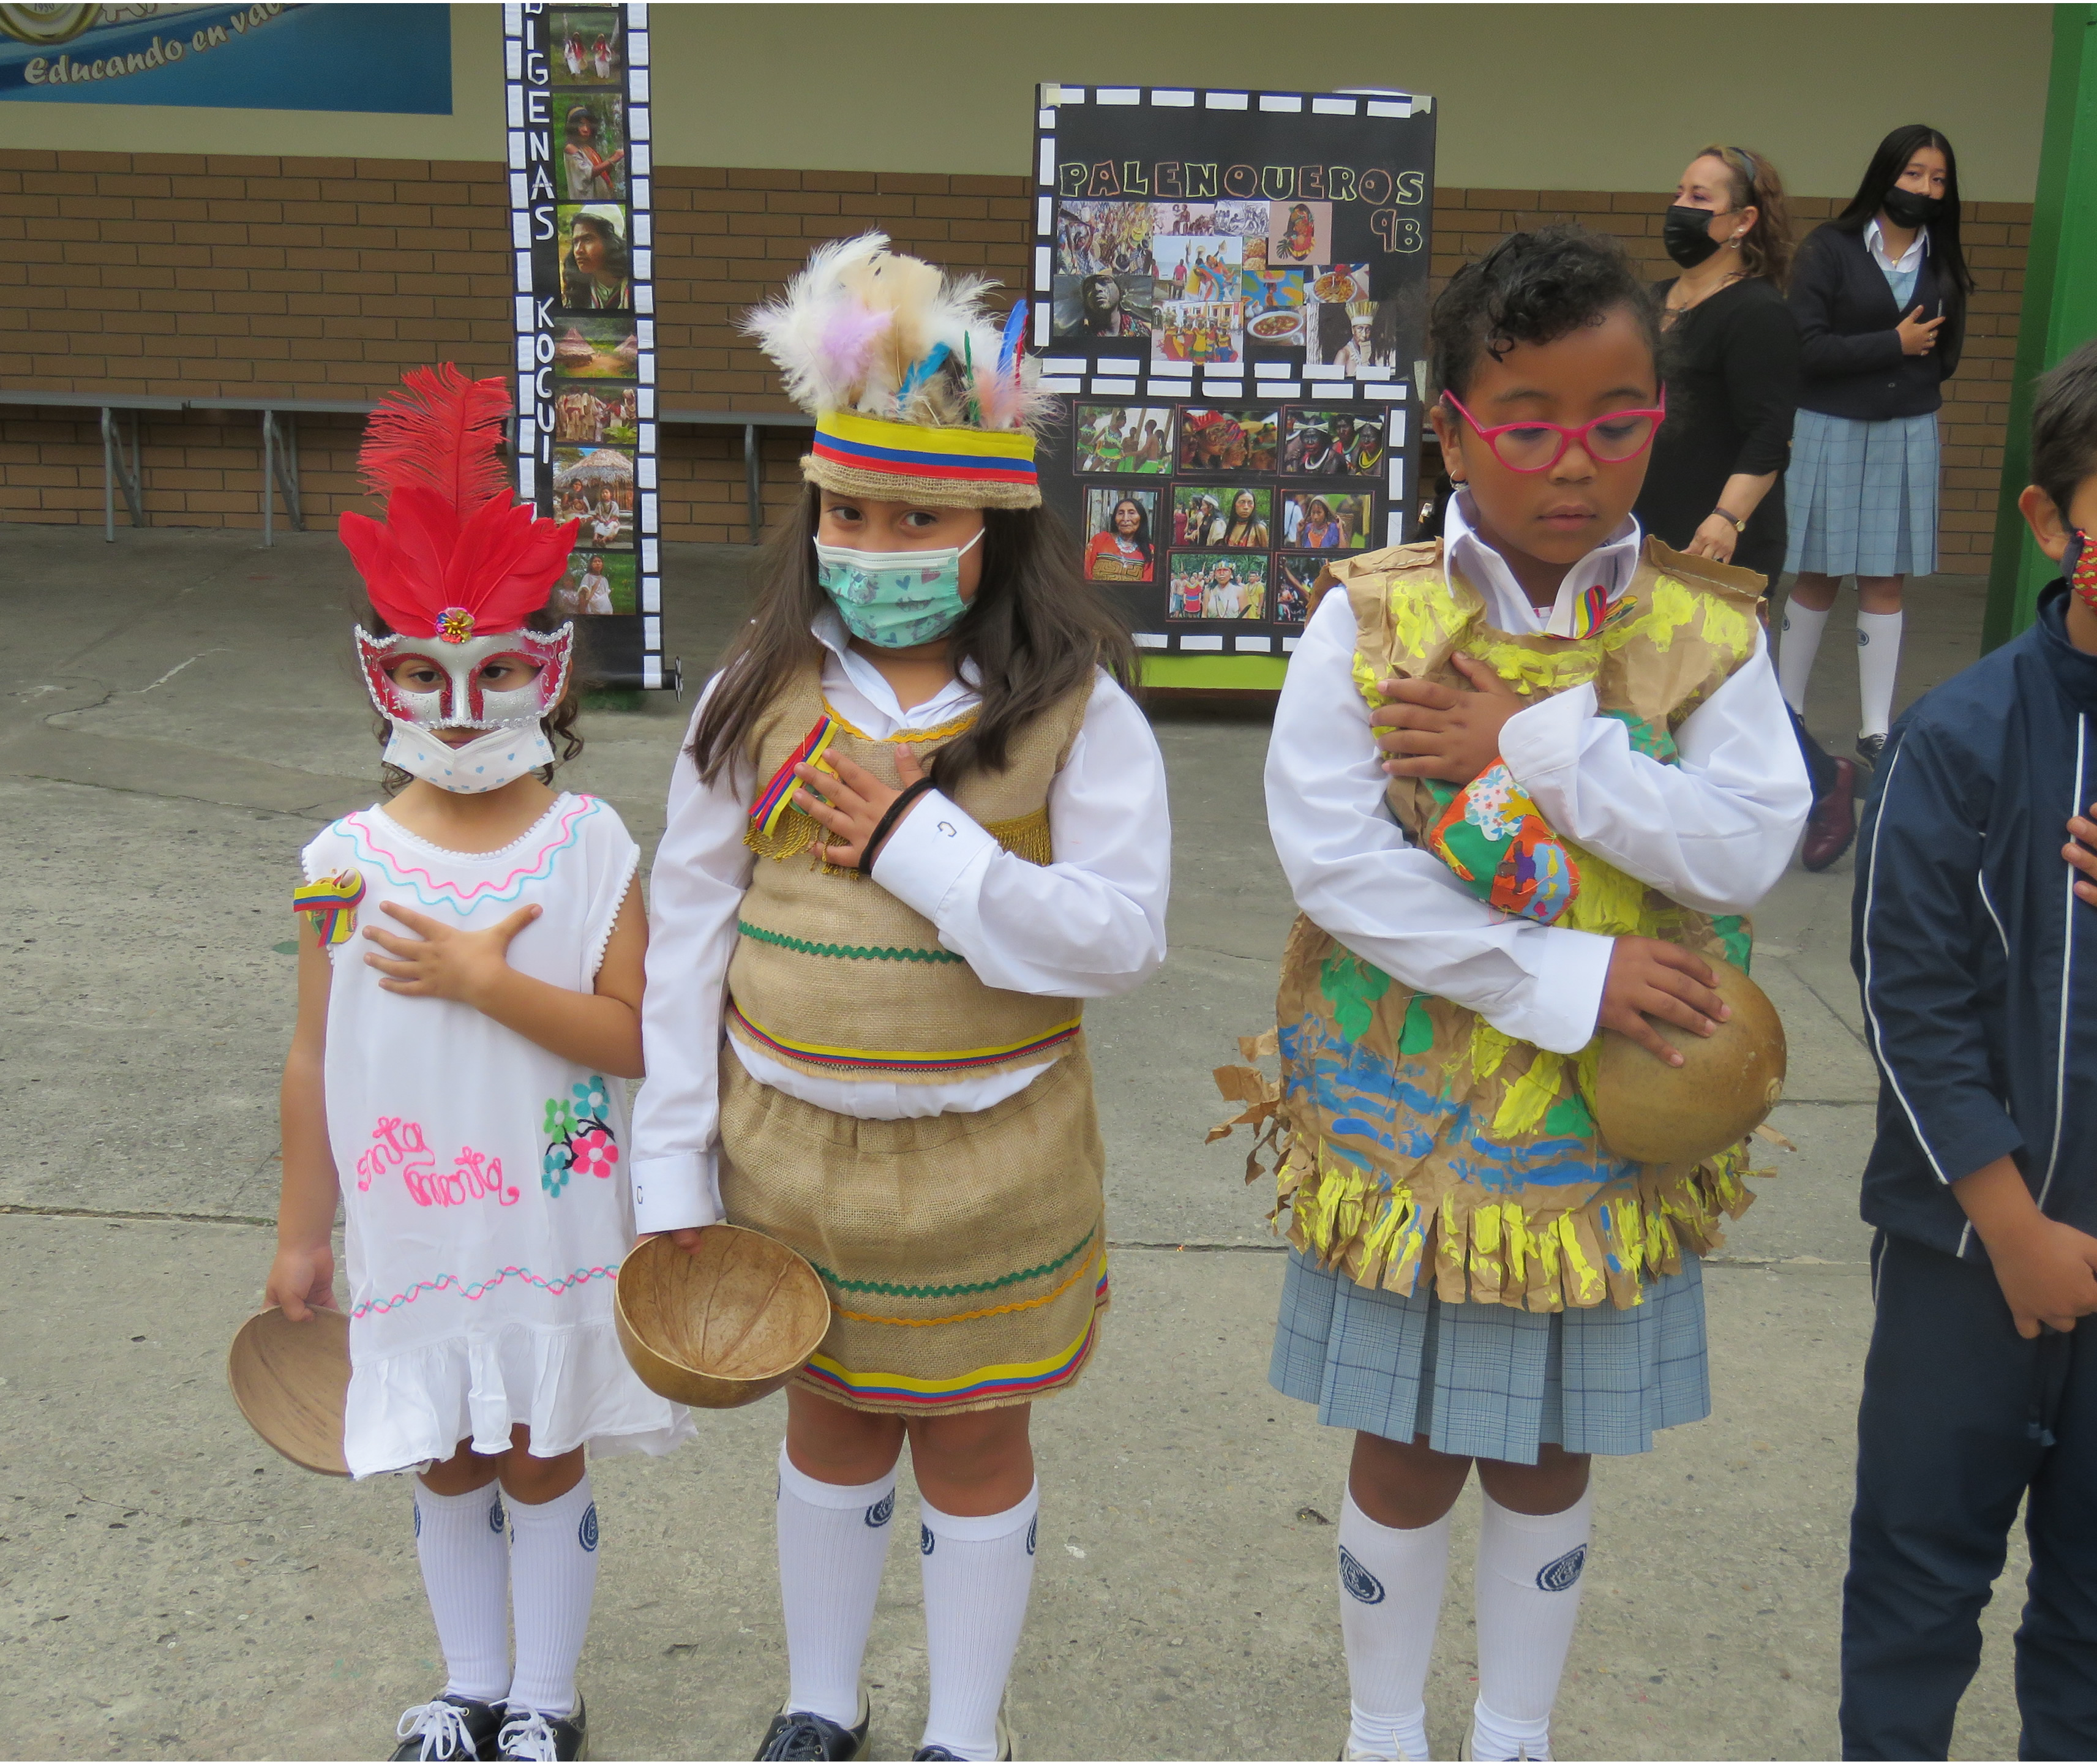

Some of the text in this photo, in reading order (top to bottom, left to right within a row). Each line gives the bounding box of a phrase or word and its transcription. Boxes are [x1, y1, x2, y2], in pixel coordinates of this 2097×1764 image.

[24, 36, 183, 84] Educando
[192, 25, 228, 52] en
[1059, 160, 1425, 206] PALENQUEROS
[1371, 209, 1423, 253] 9B
